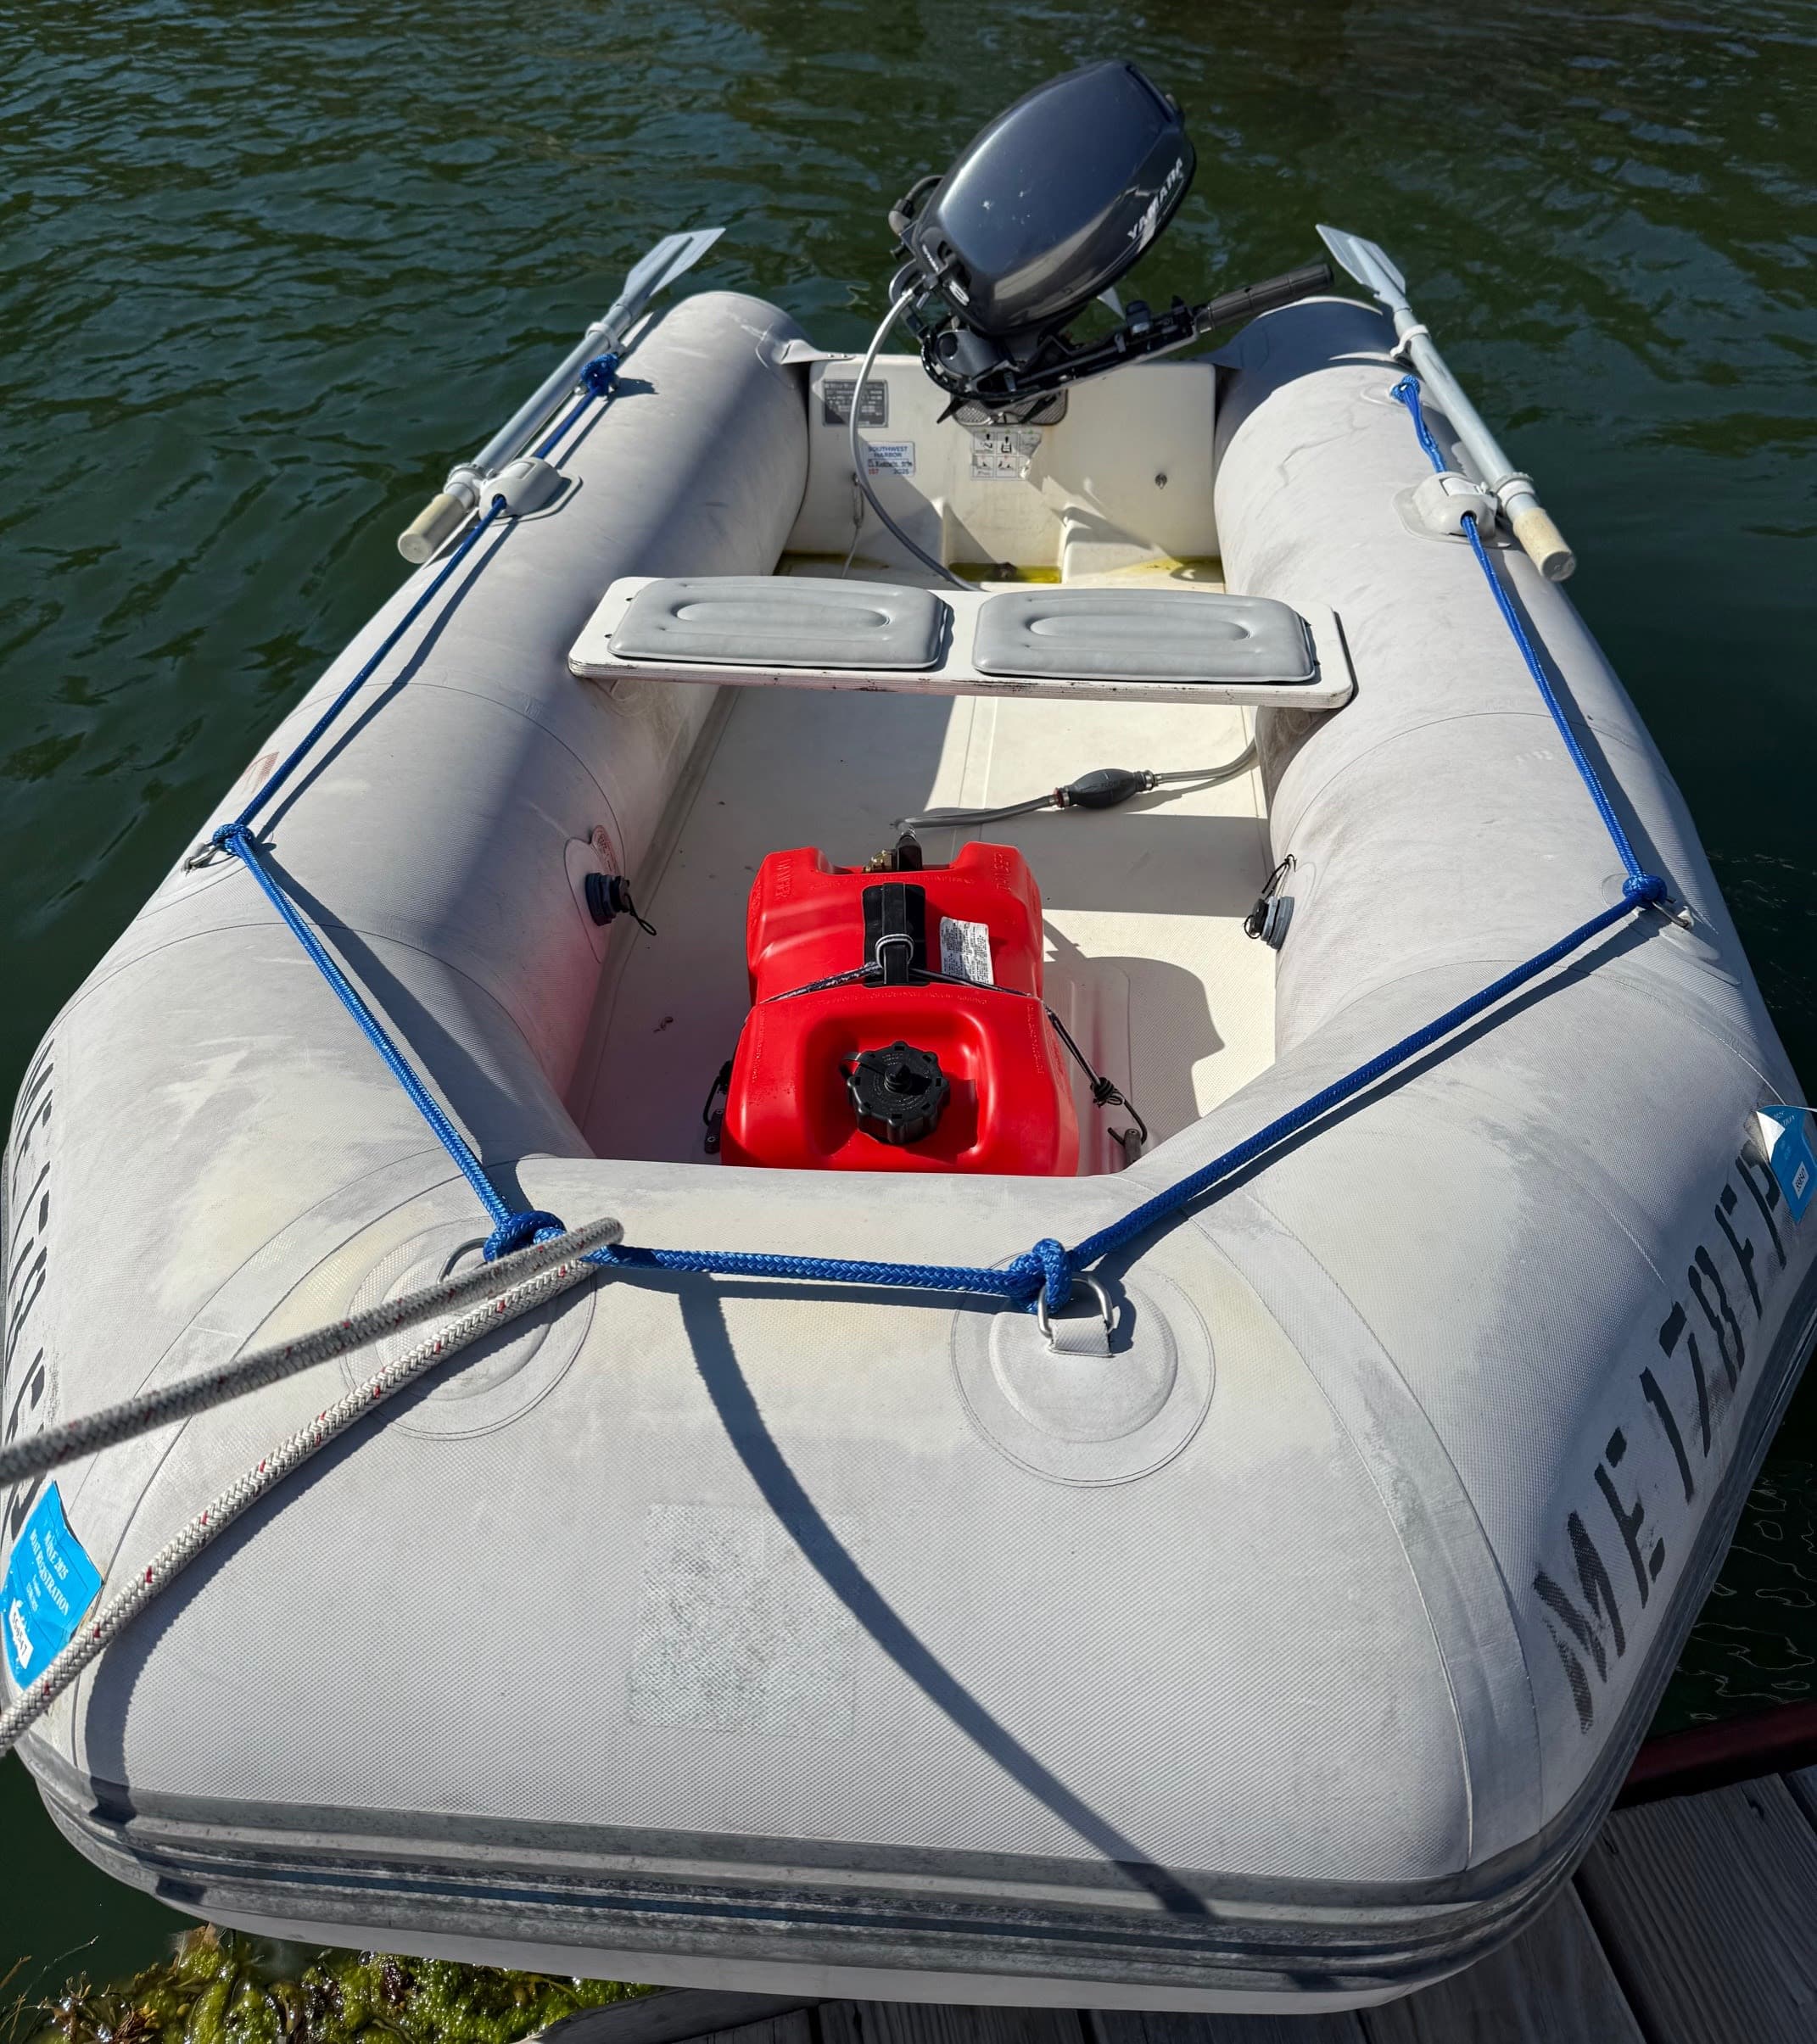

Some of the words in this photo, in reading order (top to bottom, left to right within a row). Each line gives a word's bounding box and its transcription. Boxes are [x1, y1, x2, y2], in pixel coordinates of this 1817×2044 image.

[36, 1550, 70, 1616] REGISTRATION
[44, 1530, 59, 1565] MAINE
[54, 1557, 69, 1581] 2025
[1533, 1425, 1667, 1734] ME
